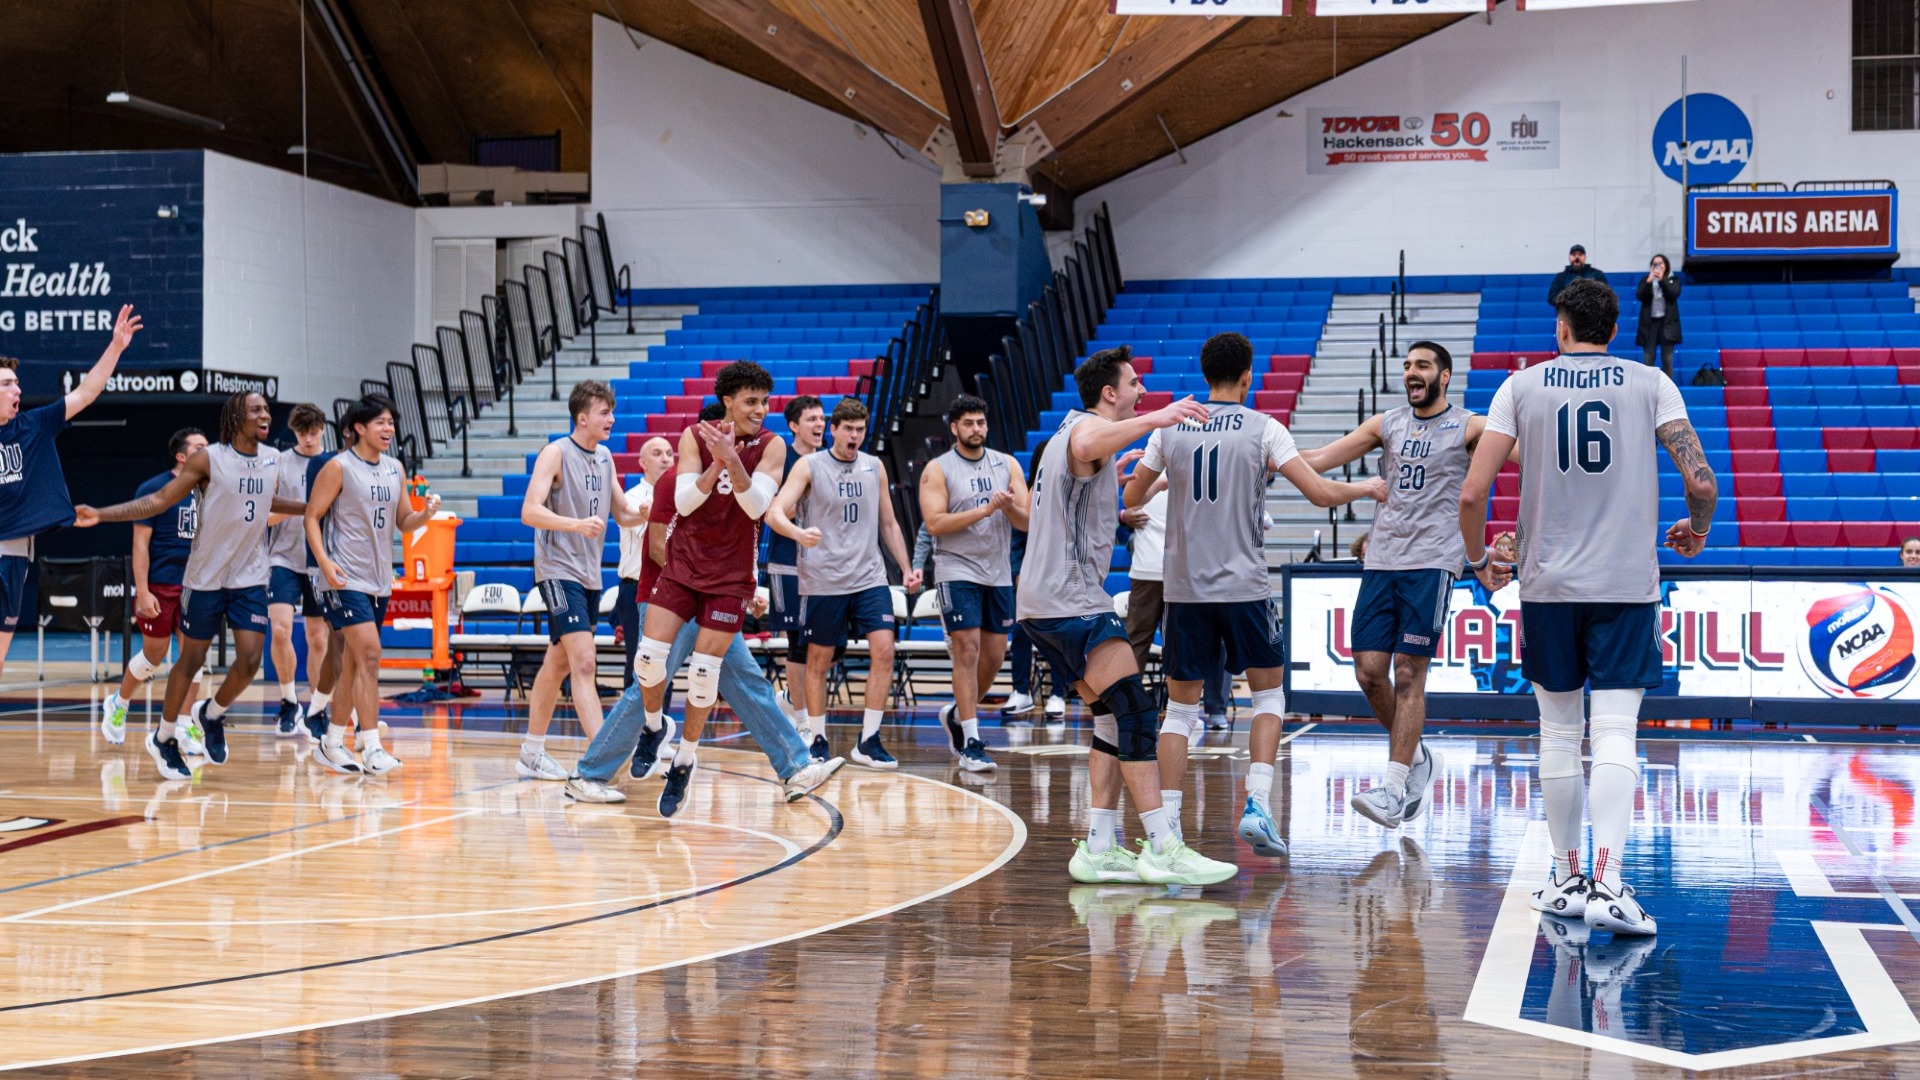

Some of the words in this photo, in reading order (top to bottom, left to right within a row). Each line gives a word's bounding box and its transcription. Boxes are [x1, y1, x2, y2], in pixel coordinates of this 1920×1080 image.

[1322, 115, 1400, 133] TOYOTA
[1431, 112, 1490, 147] 50
[1511, 120, 1538, 138] FDU
[1323, 135, 1424, 149] Hackensack
[1663, 138, 1750, 166] NCAA
[1358, 153, 1381, 163] great
[1383, 152, 1406, 162] years
[1408, 151, 1418, 159] of
[1419, 151, 1451, 161] serving
[1452, 151, 1470, 160] you.
[1707, 211, 1798, 234] STRATIS
[1803, 209, 1880, 233] ARENA
[0, 218, 39, 253] ck
[0, 262, 111, 297] Health
[25, 310, 112, 331] BETTER
[80, 370, 174, 392] stroom
[214, 374, 264, 393] Restroom
[1544, 366, 1624, 388] KNIGHTS
[1556, 398, 1612, 475] 16
[1401, 440, 1431, 458] FDU
[1192, 440, 1221, 504] 11
[1399, 464, 1426, 490] 20
[239, 478, 263, 494] FDU
[585, 475, 602, 491] FDU
[839, 482, 862, 497] FDU
[970, 477, 992, 492] FDU
[371, 486, 391, 502] FDU
[244, 500, 256, 522] 3
[589, 497, 599, 517] 13
[844, 502, 858, 523] 10
[373, 507, 386, 529] 15
[484, 586, 502, 598] FDU
[386, 599, 433, 613] TORA
[1827, 604, 1869, 634] molten
[1836, 623, 1885, 658] NCAA
